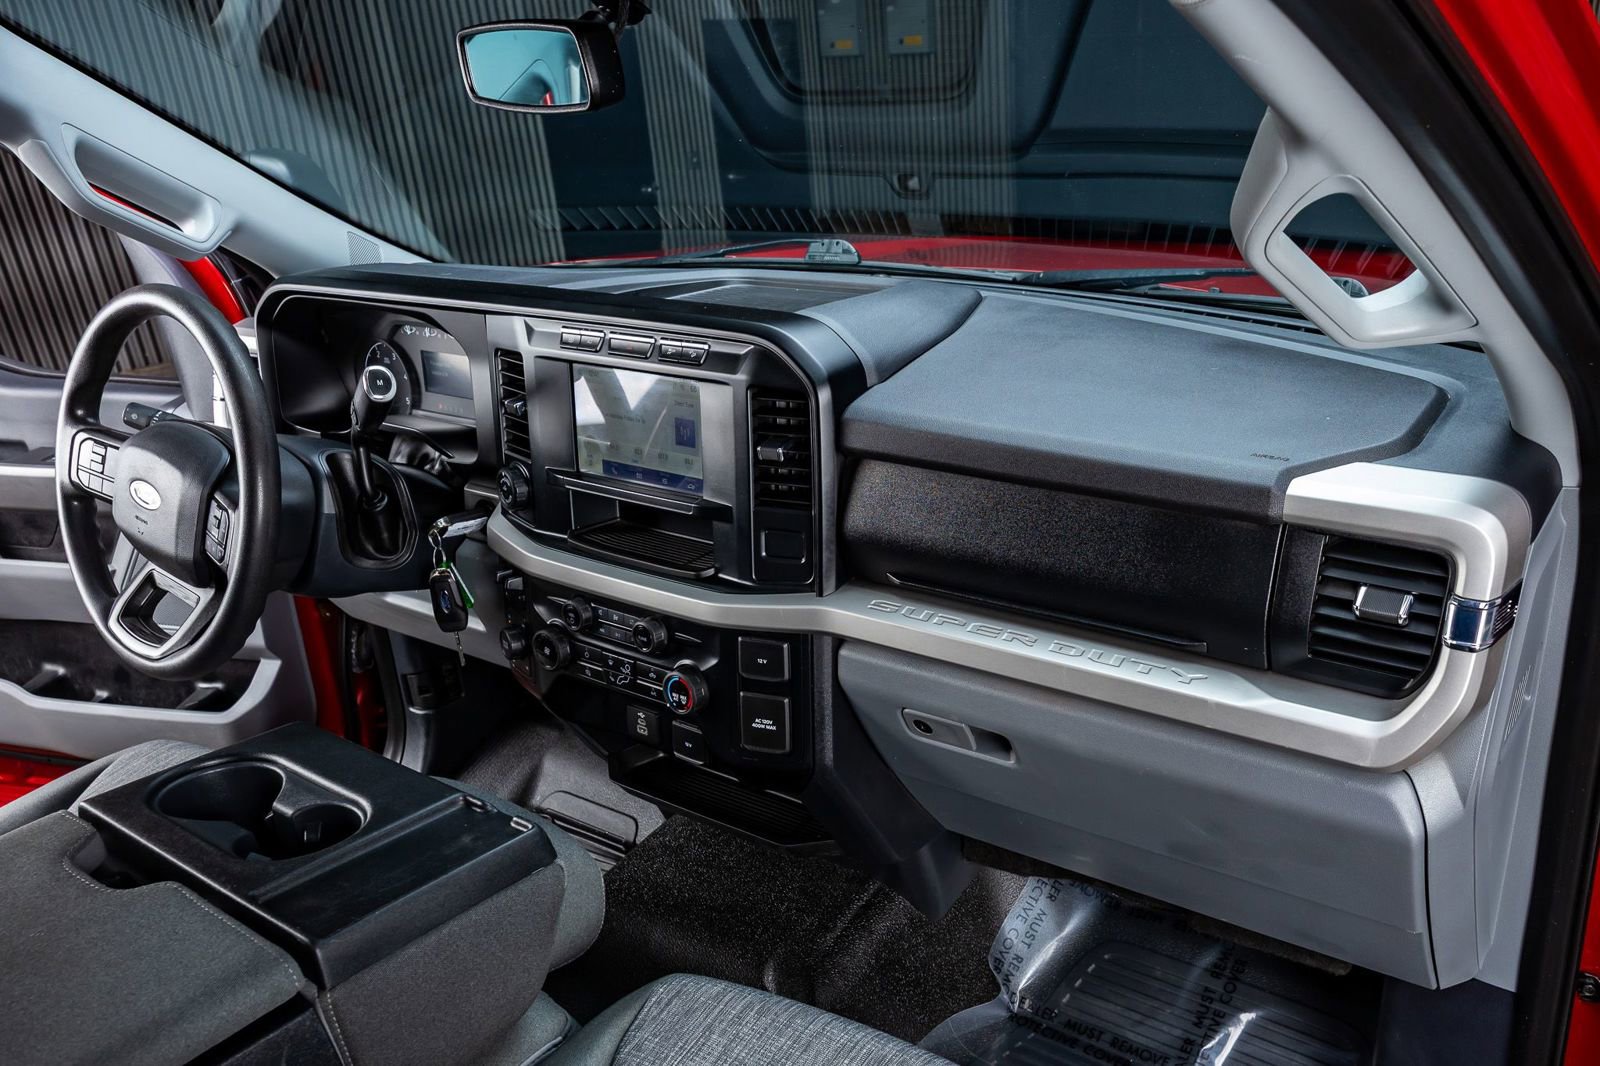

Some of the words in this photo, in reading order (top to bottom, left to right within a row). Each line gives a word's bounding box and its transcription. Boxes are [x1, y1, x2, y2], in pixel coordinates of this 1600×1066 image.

[868, 599, 1039, 648] SUPER
[1048, 640, 1208, 685] DUTY
[1016, 878, 1048, 924] ECTIVE
[1046, 879, 1064, 903] LER
[993, 927, 1019, 976] COVER
[1021, 908, 1048, 950] MUST
[1001, 953, 1024, 995] REMO
[1220, 959, 1248, 1005] COVER
[1007, 1012, 1080, 1049] ROTECTIVE
[1063, 1018, 1104, 1043] MUST
[1109, 1036, 1171, 1066] REMOVE
[1175, 1038, 1195, 1066] ALER
[1191, 986, 1218, 1029] MUST
